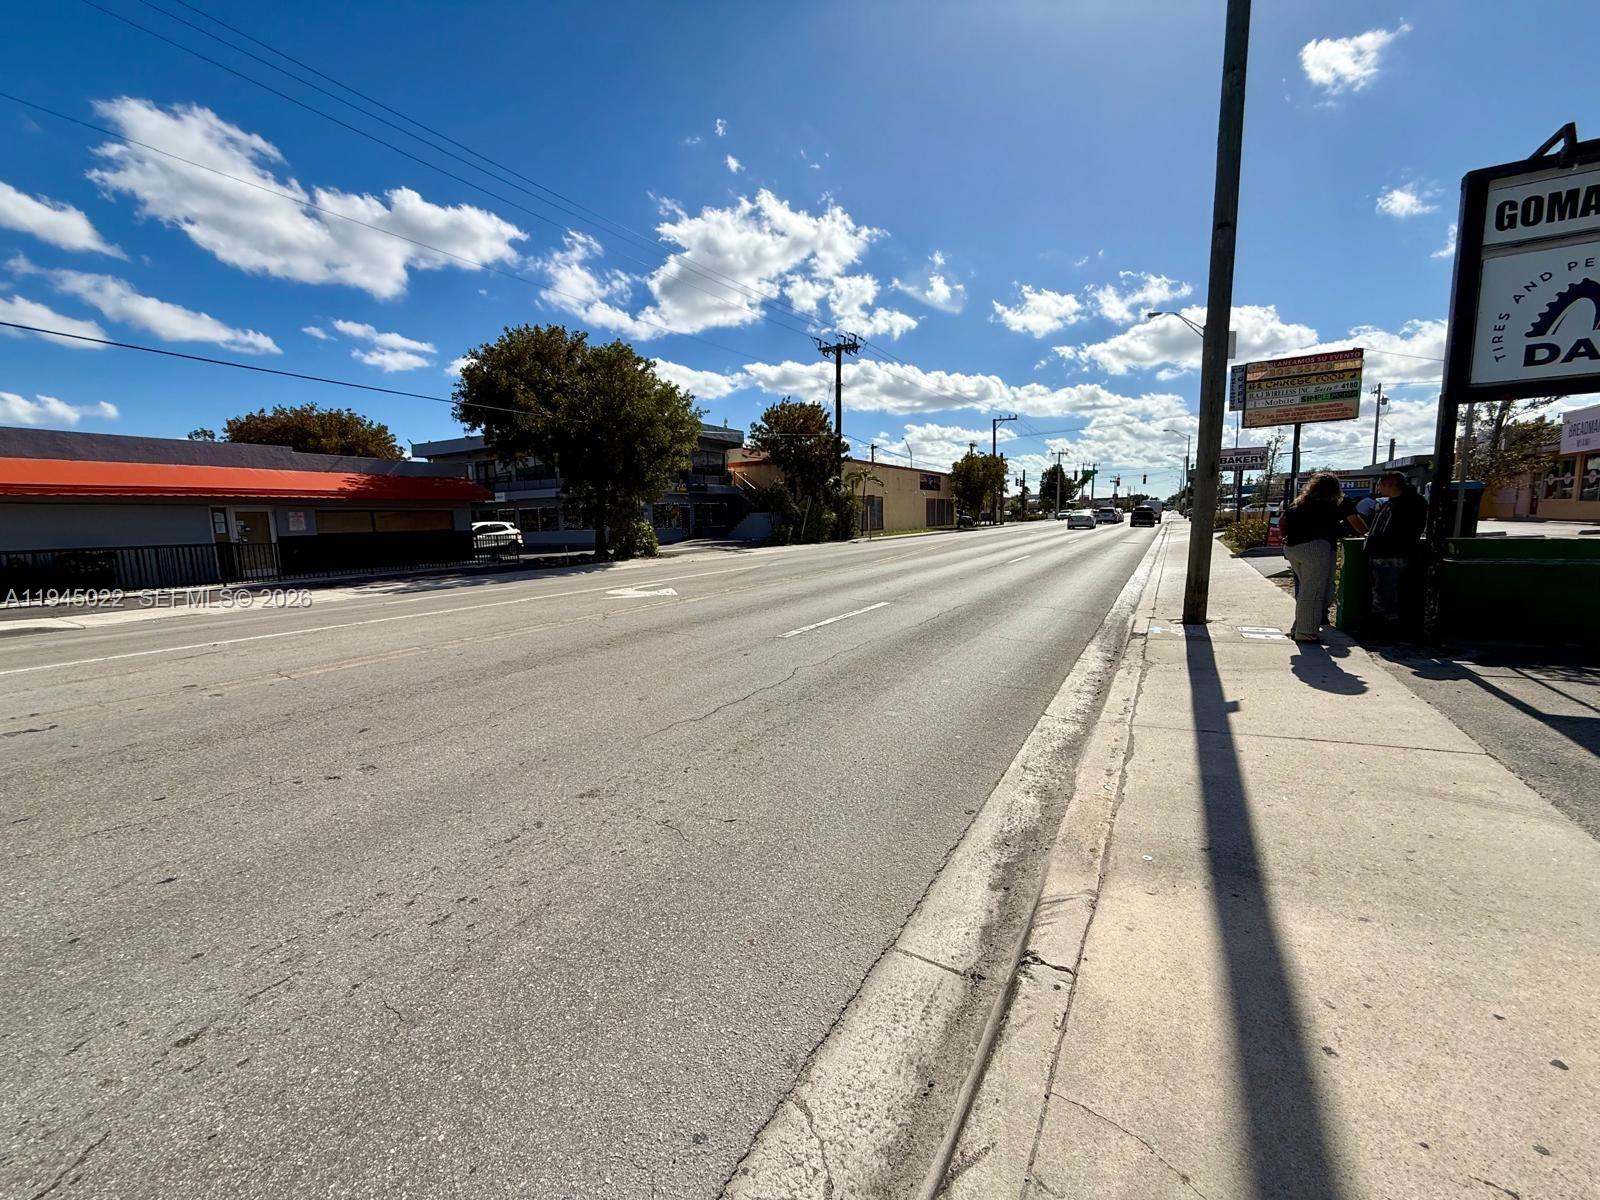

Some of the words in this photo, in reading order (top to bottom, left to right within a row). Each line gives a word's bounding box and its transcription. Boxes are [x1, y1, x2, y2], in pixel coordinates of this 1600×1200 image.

[1495, 184, 1600, 231] GOMA
[1492, 313, 1510, 362] TIRES
[1513, 272, 1552, 304] AND
[1567, 257, 1595, 271] PE
[1330, 352, 1360, 361] EVENTO
[1523, 338, 1600, 367] DA
[1265, 376, 1312, 388] CHINESE
[1315, 373, 1345, 383] FOOD
[1220, 455, 1266, 465] BAKERY
